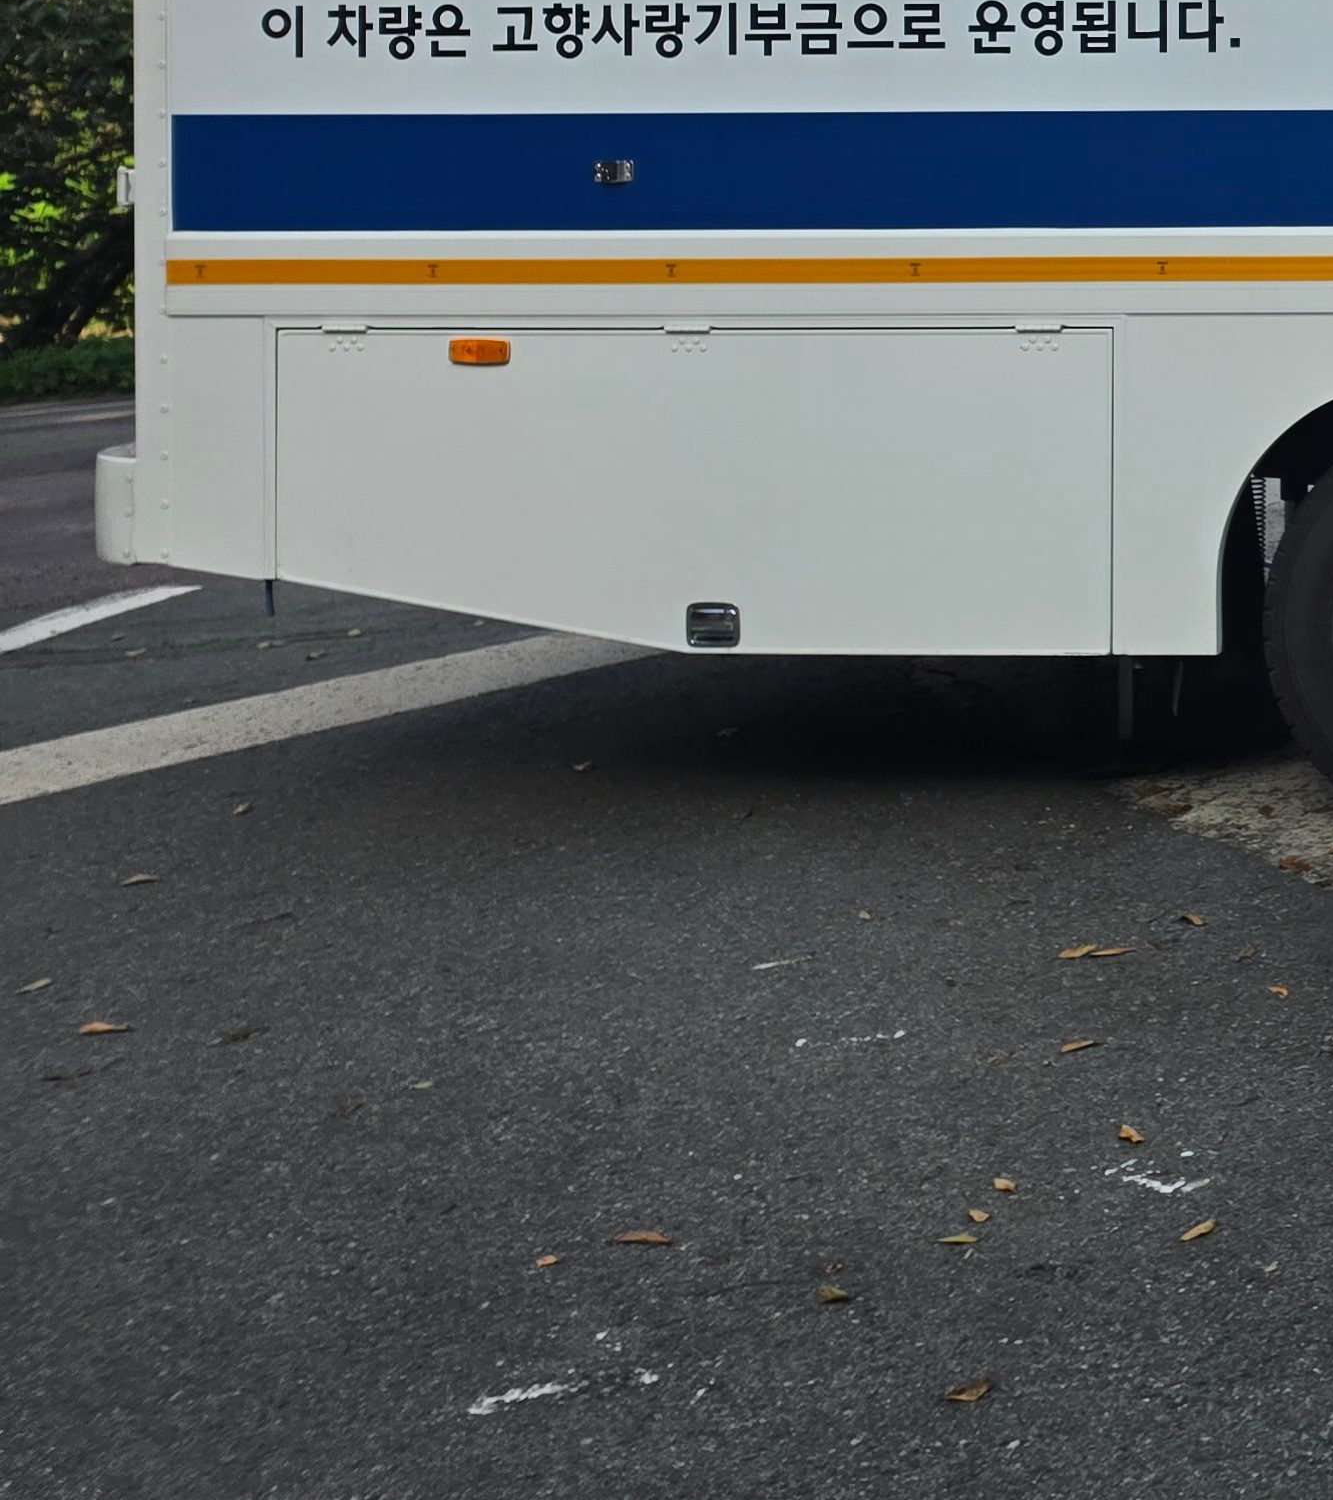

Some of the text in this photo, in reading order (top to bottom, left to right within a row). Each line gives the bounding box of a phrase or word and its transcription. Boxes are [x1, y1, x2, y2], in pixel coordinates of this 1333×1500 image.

[261, 0, 1241, 61] 이 차량은 고향사랑기부금으로 운영됩니다.
